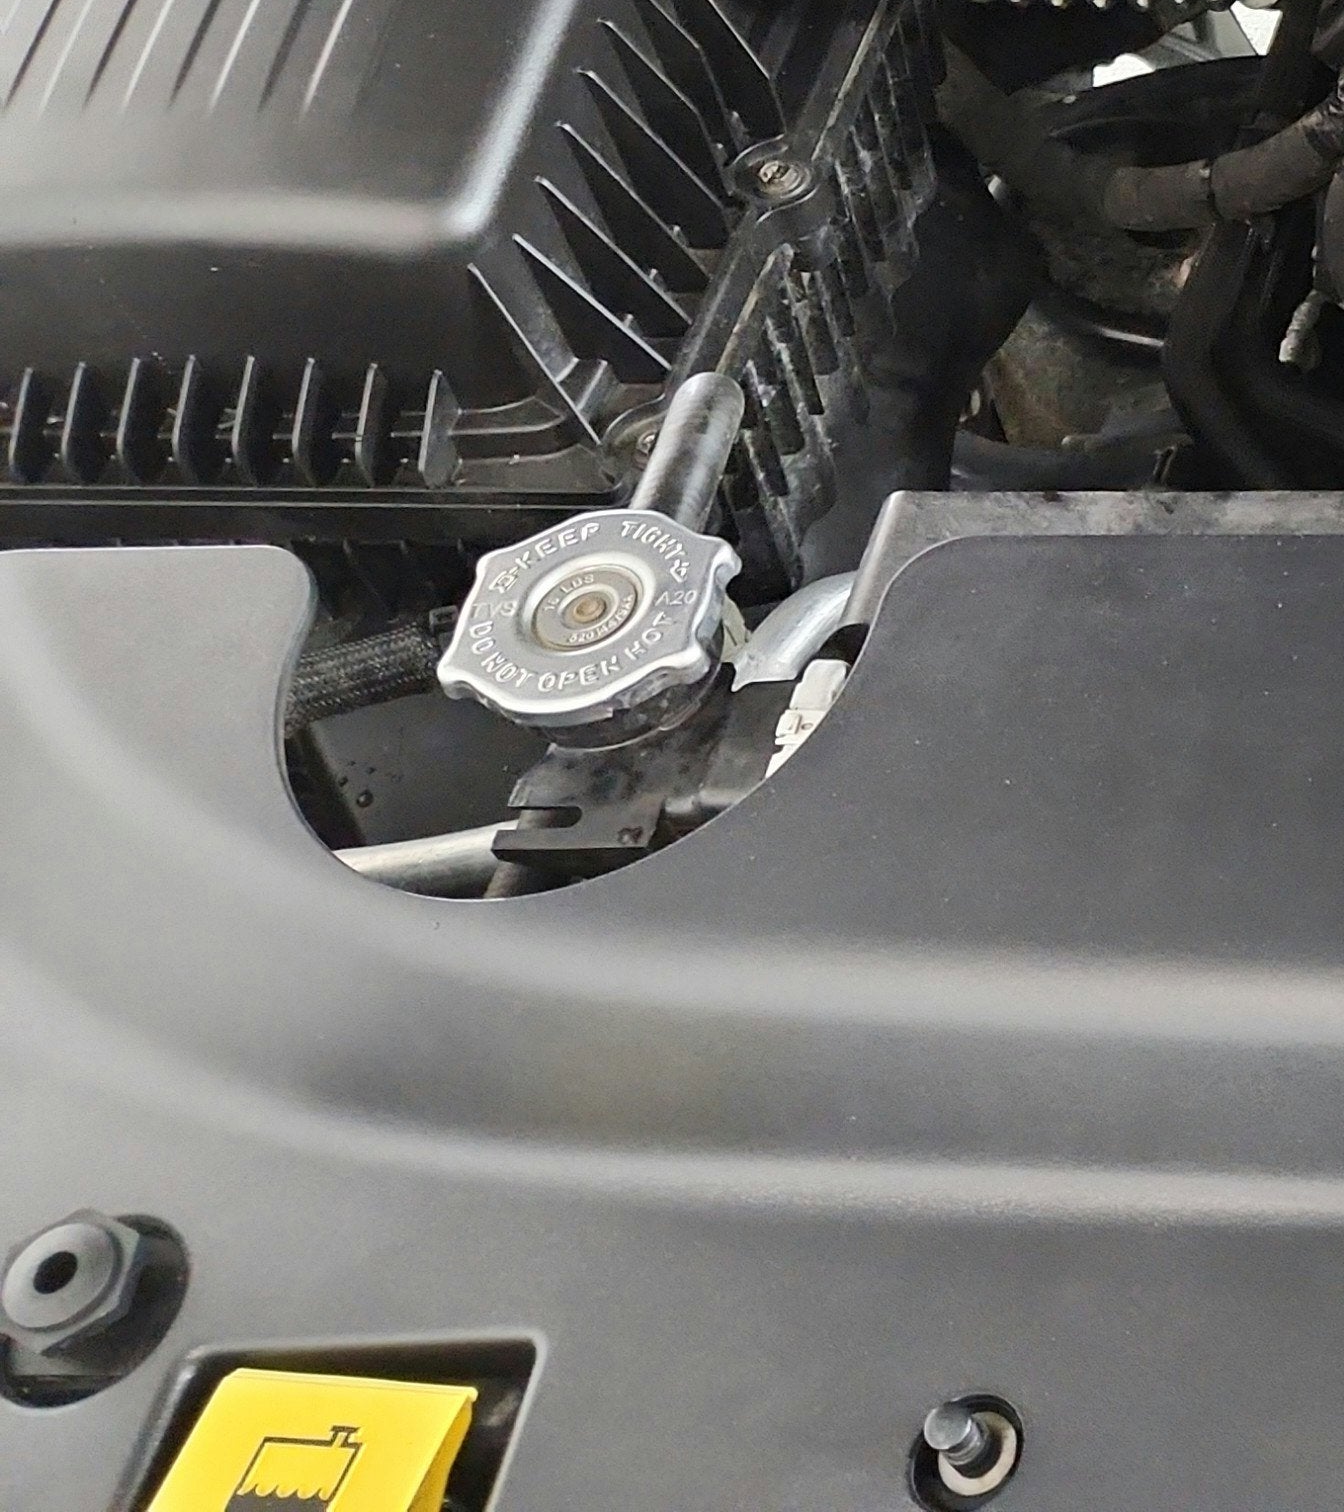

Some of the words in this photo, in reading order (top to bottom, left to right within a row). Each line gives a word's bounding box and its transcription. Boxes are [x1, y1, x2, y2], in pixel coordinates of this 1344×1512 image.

[518, 521, 601, 570] KEEP
[622, 519, 687, 565] TIGHT
[471, 601, 518, 619] TVS
[655, 589, 698, 607] A20
[468, 620, 493, 661] DO
[626, 609, 675, 662] HOT
[480, 655, 538, 690] NOT
[537, 656, 623, 693] OPEN
